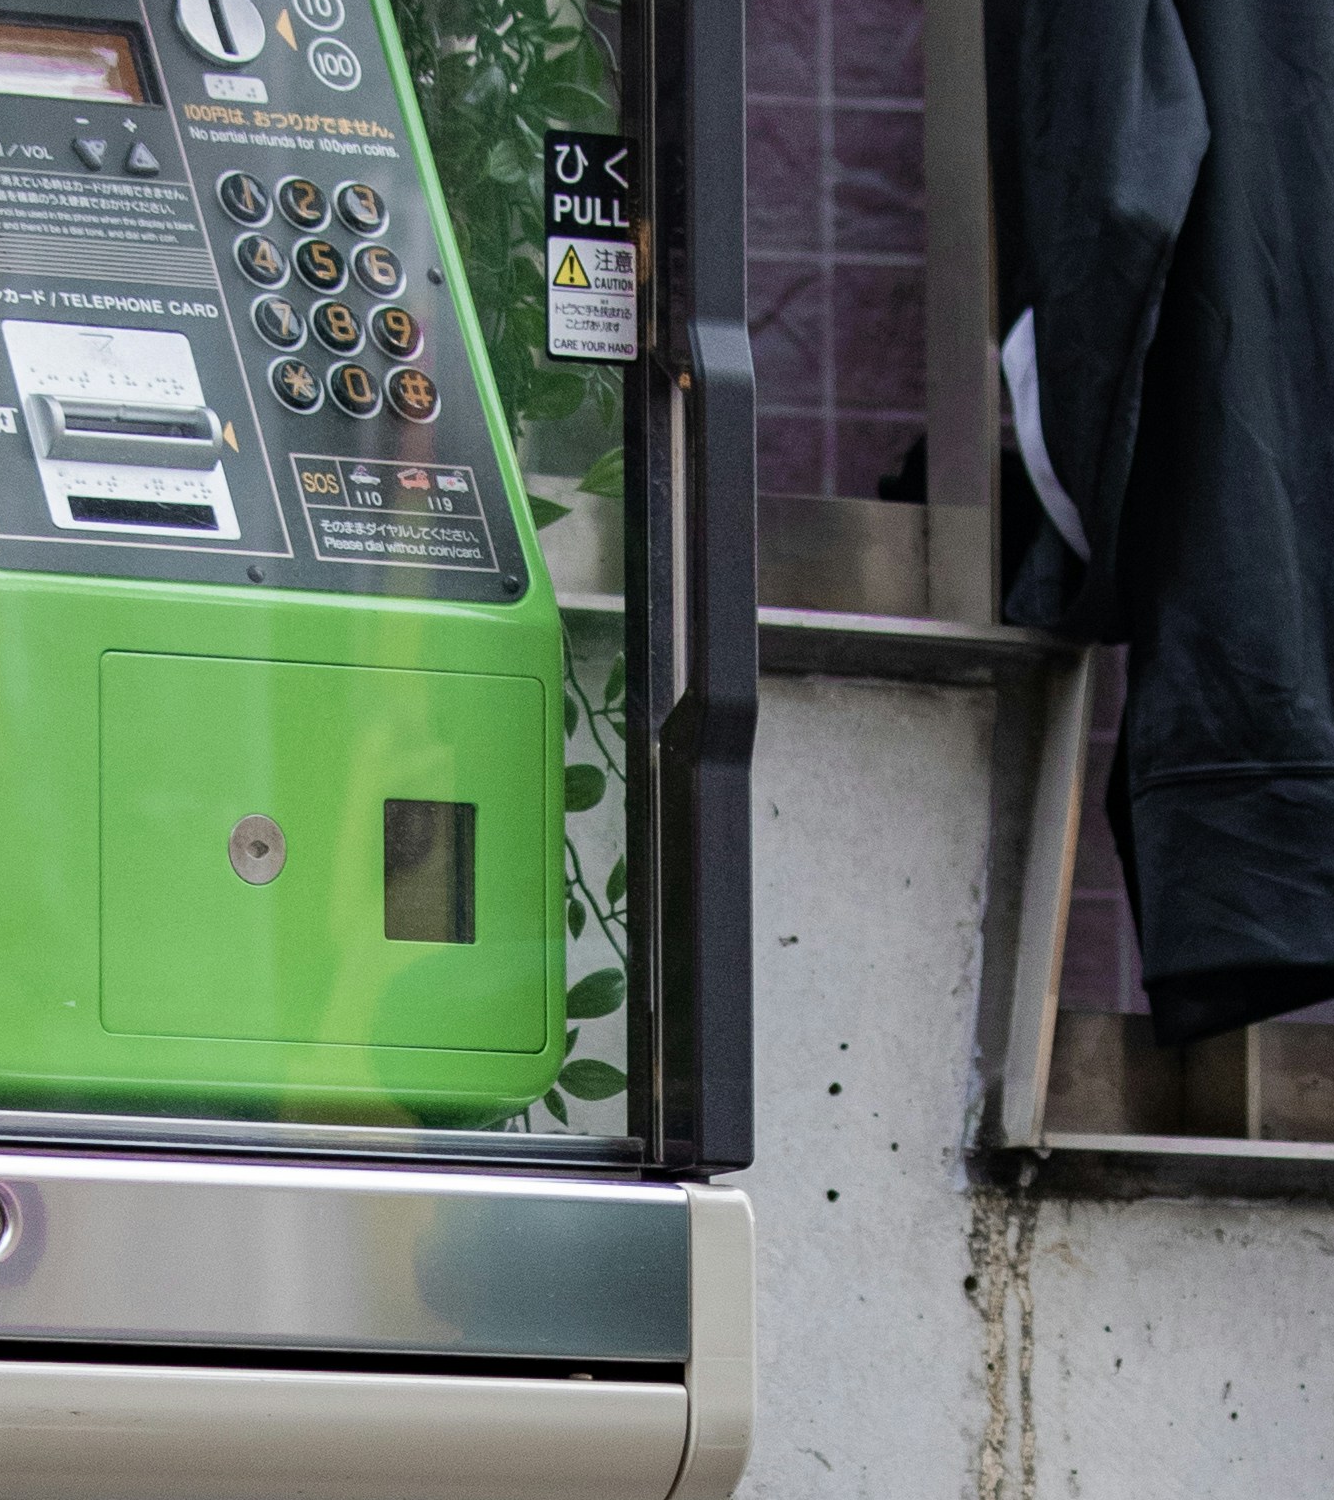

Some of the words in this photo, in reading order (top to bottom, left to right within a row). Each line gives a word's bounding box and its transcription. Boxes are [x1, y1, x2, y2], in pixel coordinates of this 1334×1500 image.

[316, 51, 354, 77] 100
[189, 125, 208, 141] No
[210, 129, 248, 146] partial
[249, 131, 297, 150] refunds
[298, 136, 315, 150] for
[362, 142, 400, 159] coins.
[293, 180, 322, 220] 2
[352, 185, 380, 225] 3
[553, 193, 630, 228] PULL
[254, 238, 278, 276] 4
[310, 241, 338, 282] 5
[368, 247, 397, 286] 6
[594, 247, 634, 274] 注意
[594, 276, 634, 292] CAUTION
[59, 291, 166, 315] TELEPHONE
[167, 300, 219, 319] CARD
[269, 301, 291, 338] 7
[325, 304, 357, 341] 8
[384, 309, 413, 348] 9
[553, 337, 579, 351] CARE
[581, 339, 607, 353] YOUR
[607, 341, 634, 355] HAND
[342, 366, 373, 405] 0
[301, 471, 341, 495] SOS
[355, 489, 383, 507] 110
[427, 495, 454, 513] 119
[323, 536, 364, 552] Please
[365, 539, 385, 553] dial
[386, 541, 428, 557] without
